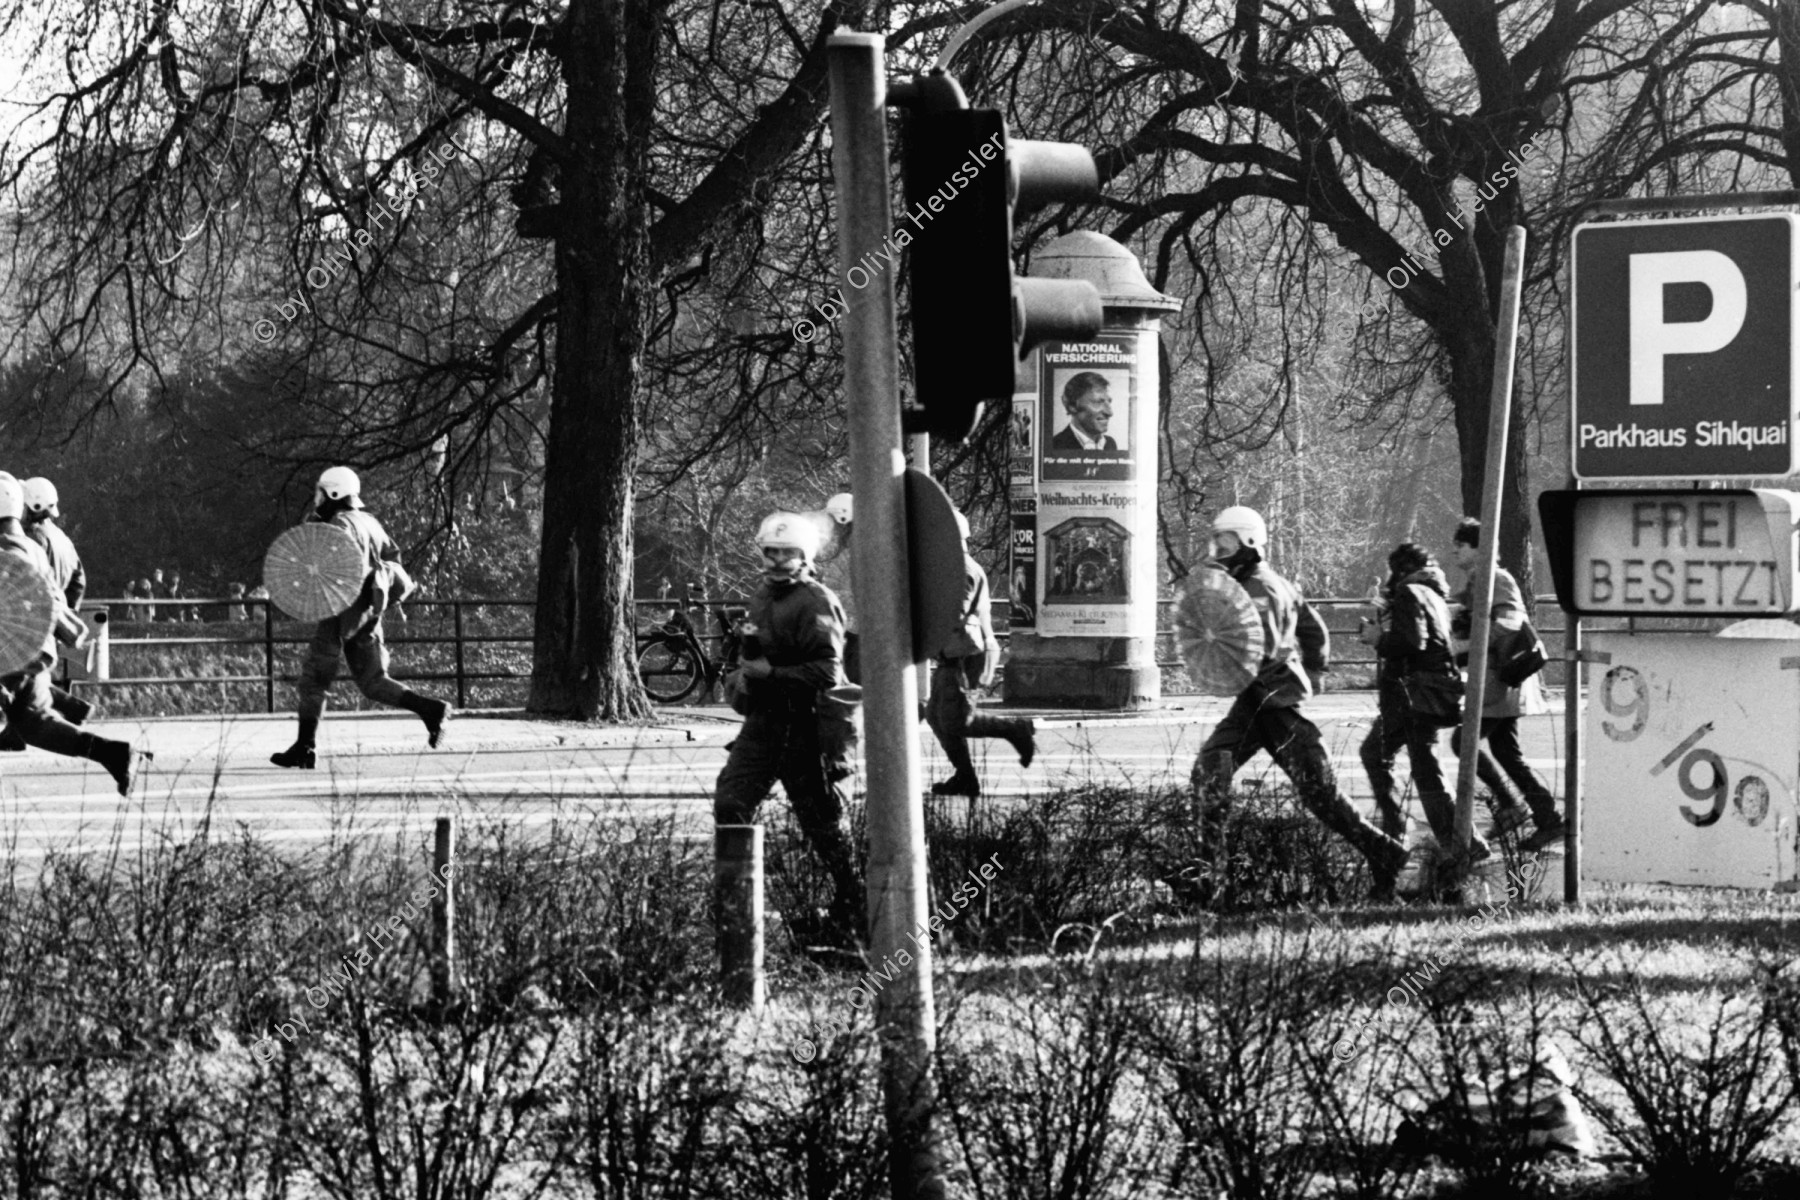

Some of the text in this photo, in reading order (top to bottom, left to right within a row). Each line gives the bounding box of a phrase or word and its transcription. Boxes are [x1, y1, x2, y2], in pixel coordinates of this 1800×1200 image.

[1629, 249, 1748, 405] P
[1045, 353, 1137, 364] VERSICHERUNG
[1061, 343, 1123, 354] NATIONAL
[1580, 421, 1787, 451] Parkhaus Sihlquai
[1040, 492, 1138, 509] Weihnachts-Krippen
[1631, 501, 1737, 549] FREI
[1590, 558, 1778, 606] BESETZT
